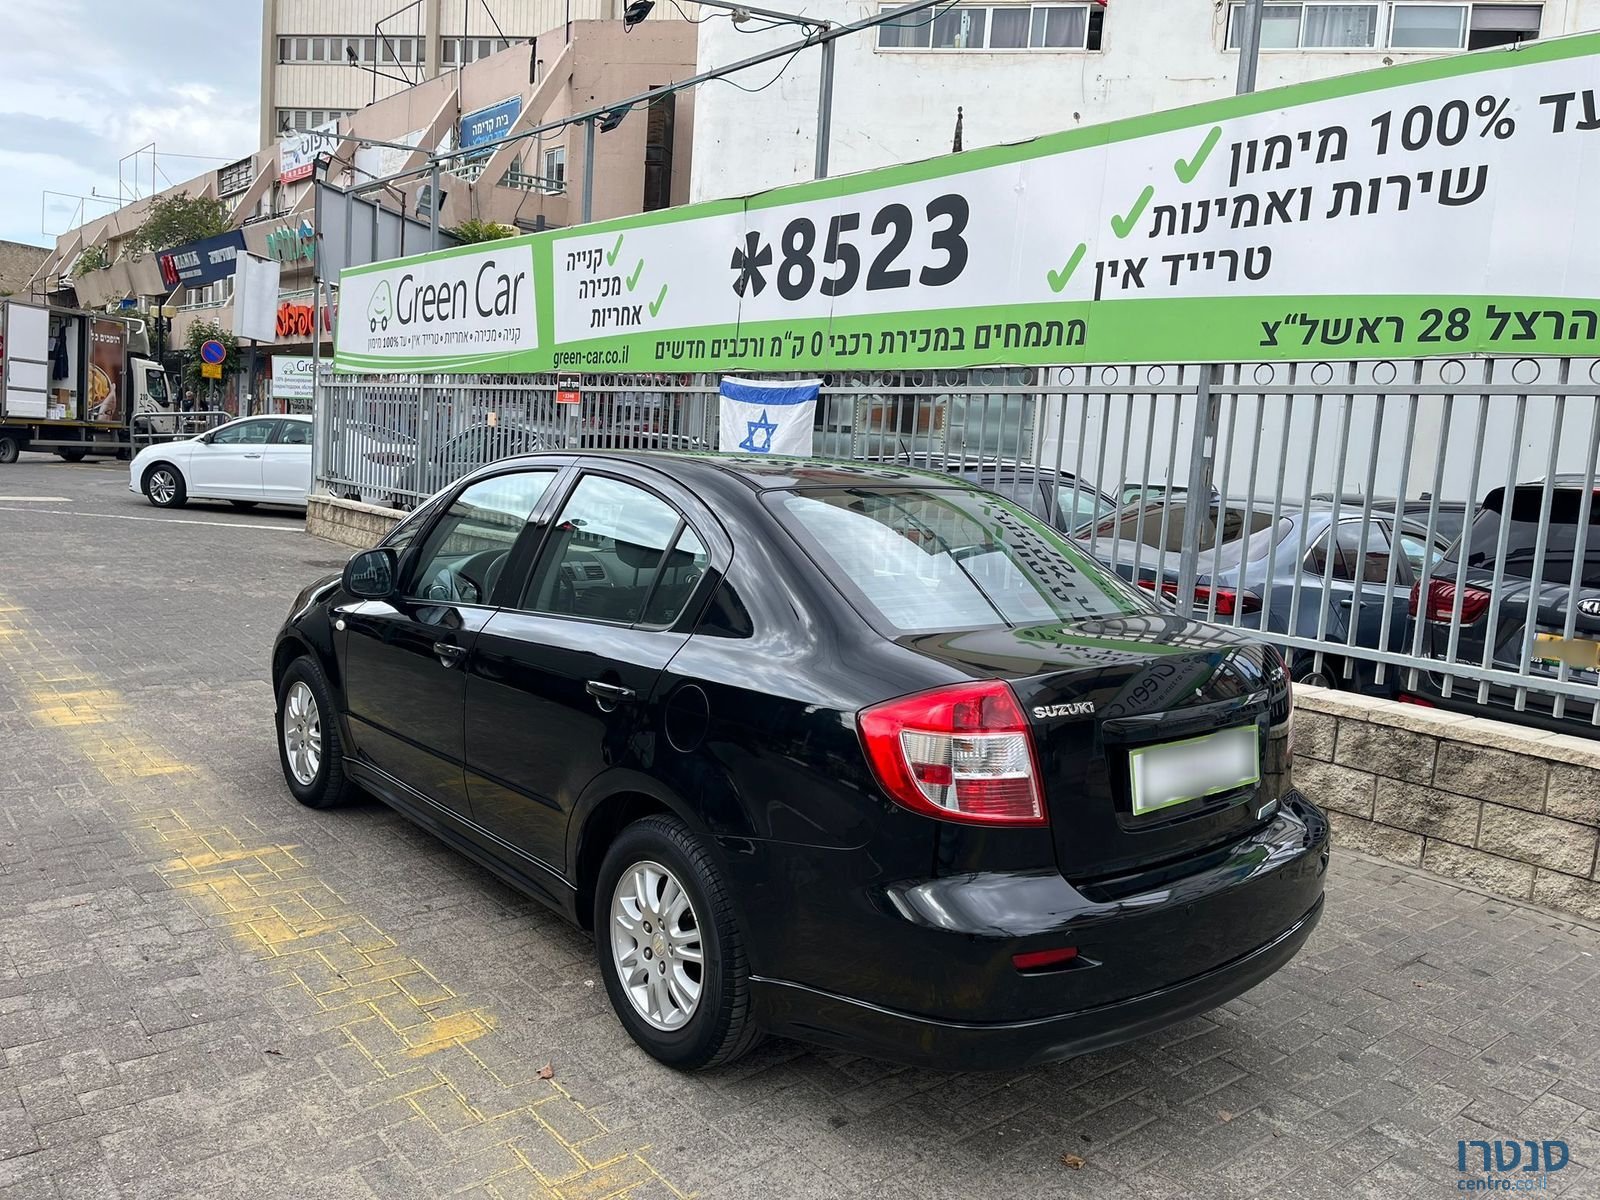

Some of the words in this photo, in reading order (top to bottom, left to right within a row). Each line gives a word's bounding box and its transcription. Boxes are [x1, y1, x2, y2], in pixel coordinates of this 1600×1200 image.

[1371, 94, 1515, 155] 100%
[1539, 90, 1600, 134] עד
[1229, 125, 1348, 187] מימון
[1326, 164, 1489, 219] שירות
[1149, 186, 1312, 238] ואמינות
[566, 248, 603, 274] קנייה
[1161, 245, 1272, 286] טרייד
[396, 273, 468, 325] Green
[474, 260, 525, 318] Car
[578, 275, 622, 299] מכירה
[1093, 257, 1149, 301] אין
[590, 304, 643, 328] אחריות
[1259, 312, 1405, 346] ראשל"צ
[1416, 307, 1471, 342] 28
[1485, 304, 1598, 340] הרצל
[382, 336, 399, 348] 100%
[444, 331, 469, 345] אחריות
[474, 329, 496, 343] מכירה
[503, 327, 521, 345] קניה
[770, 330, 805, 359] ק"מ
[811, 330, 824, 357] 0
[829, 332, 873, 357] רכבי
[878, 326, 965, 355] במכירת
[973, 318, 1086, 350] מתמחים
[553, 344, 629, 369] green-car.co.il
[655, 338, 706, 360] חדשים
[710, 337, 765, 359] ורכבים
[296, 360, 313, 373] Gre
[1582, 601, 1600, 614] KI
[1033, 701, 1096, 719] SUZUKI
